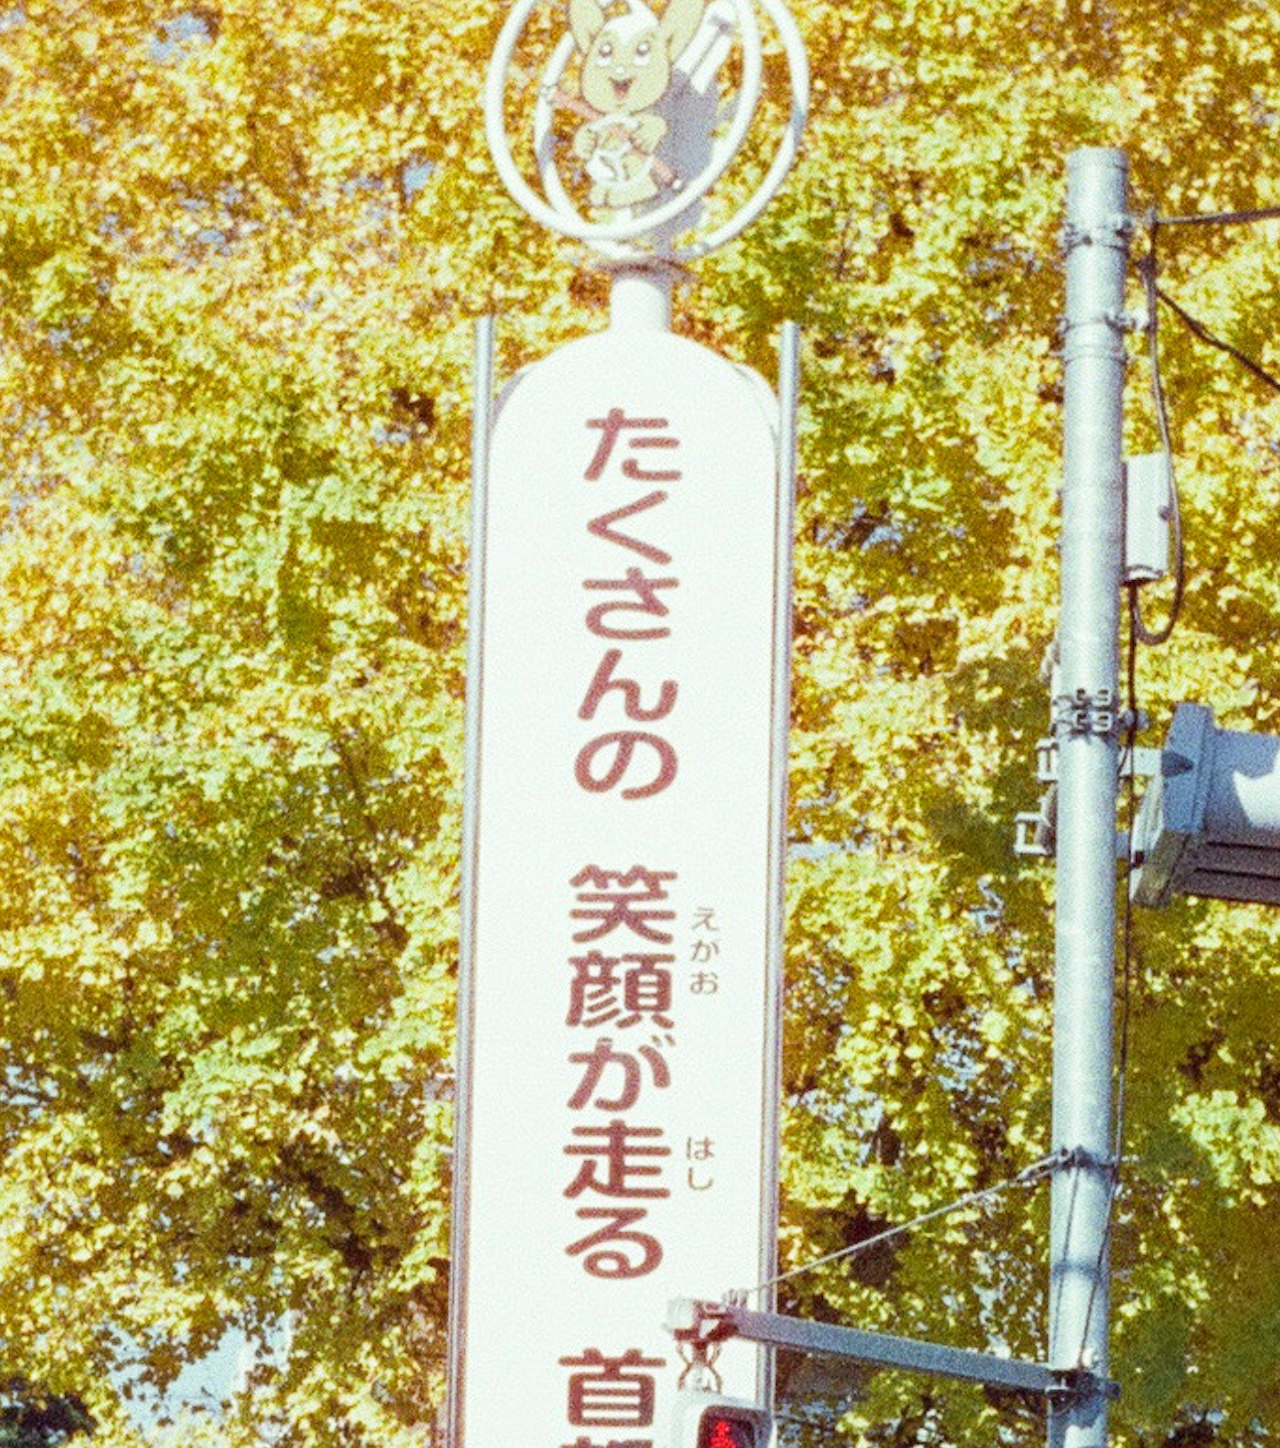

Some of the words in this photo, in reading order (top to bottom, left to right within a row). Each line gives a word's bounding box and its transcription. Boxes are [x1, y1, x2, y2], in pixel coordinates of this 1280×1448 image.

[574, 407, 682, 800] たくさんの
[563, 864, 677, 1280] 笑顔が走る
[685, 1135, 716, 1191] はし
